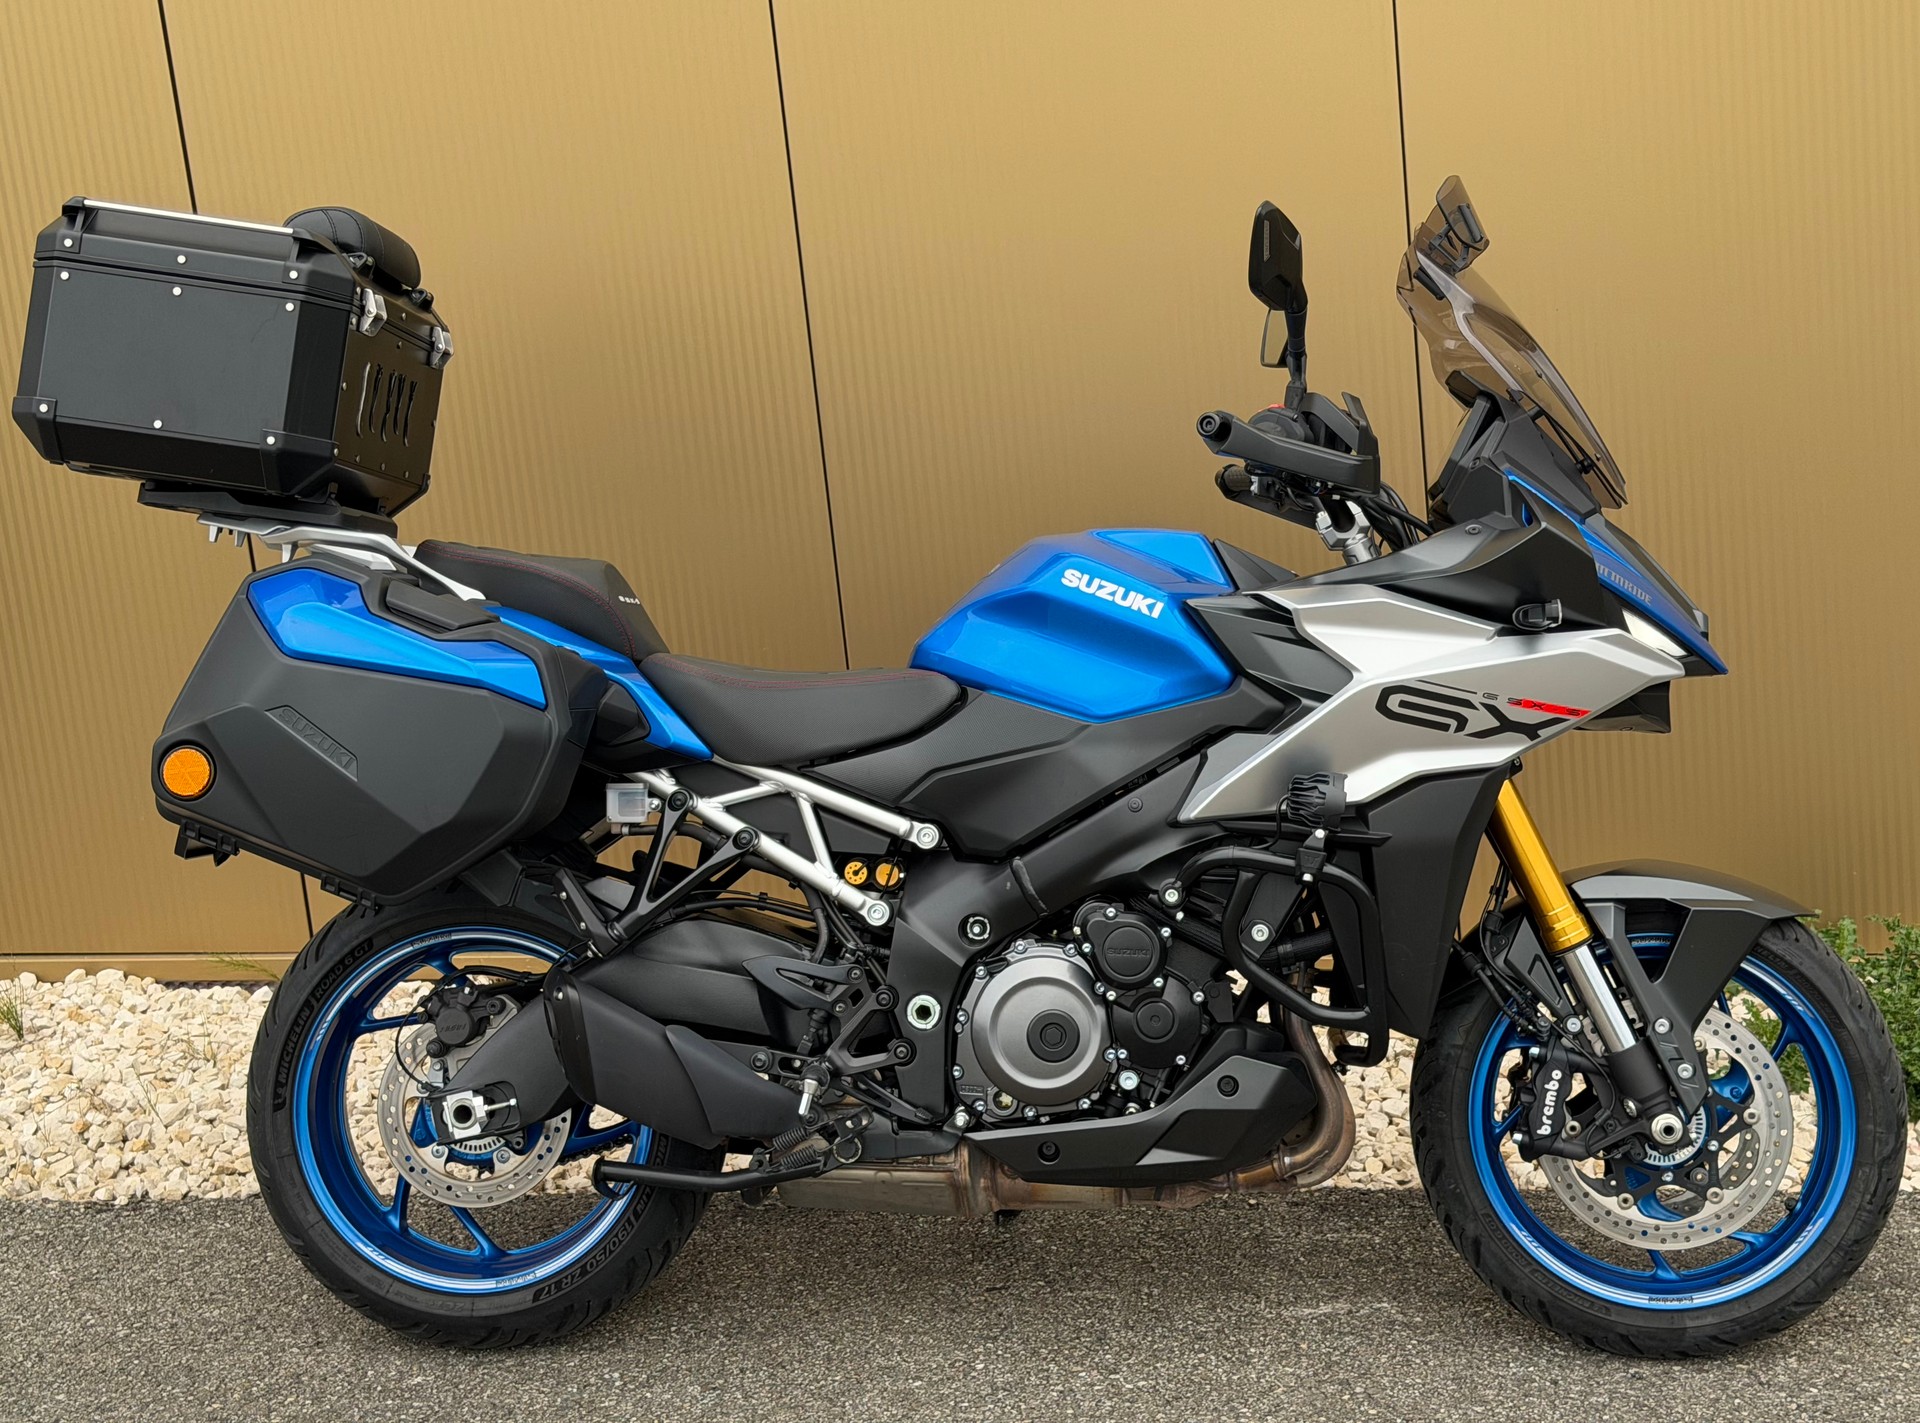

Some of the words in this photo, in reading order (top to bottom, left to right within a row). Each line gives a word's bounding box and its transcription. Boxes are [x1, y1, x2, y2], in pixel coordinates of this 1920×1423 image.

[1061, 568, 1165, 619] SUZUKI
[279, 708, 355, 771] SUZUKI
[1106, 947, 1150, 958] SUZUKI
[280, 1006, 312, 1086] MICHELIN
[316, 963, 343, 1000] ROAD
[344, 955, 352, 965] 6
[354, 941, 371, 957] GT
[1536, 1069, 1562, 1135] brembo
[587, 1217, 633, 1272] 190/50
[539, 1284, 555, 1300] 17
[561, 1271, 582, 1288] ZR
